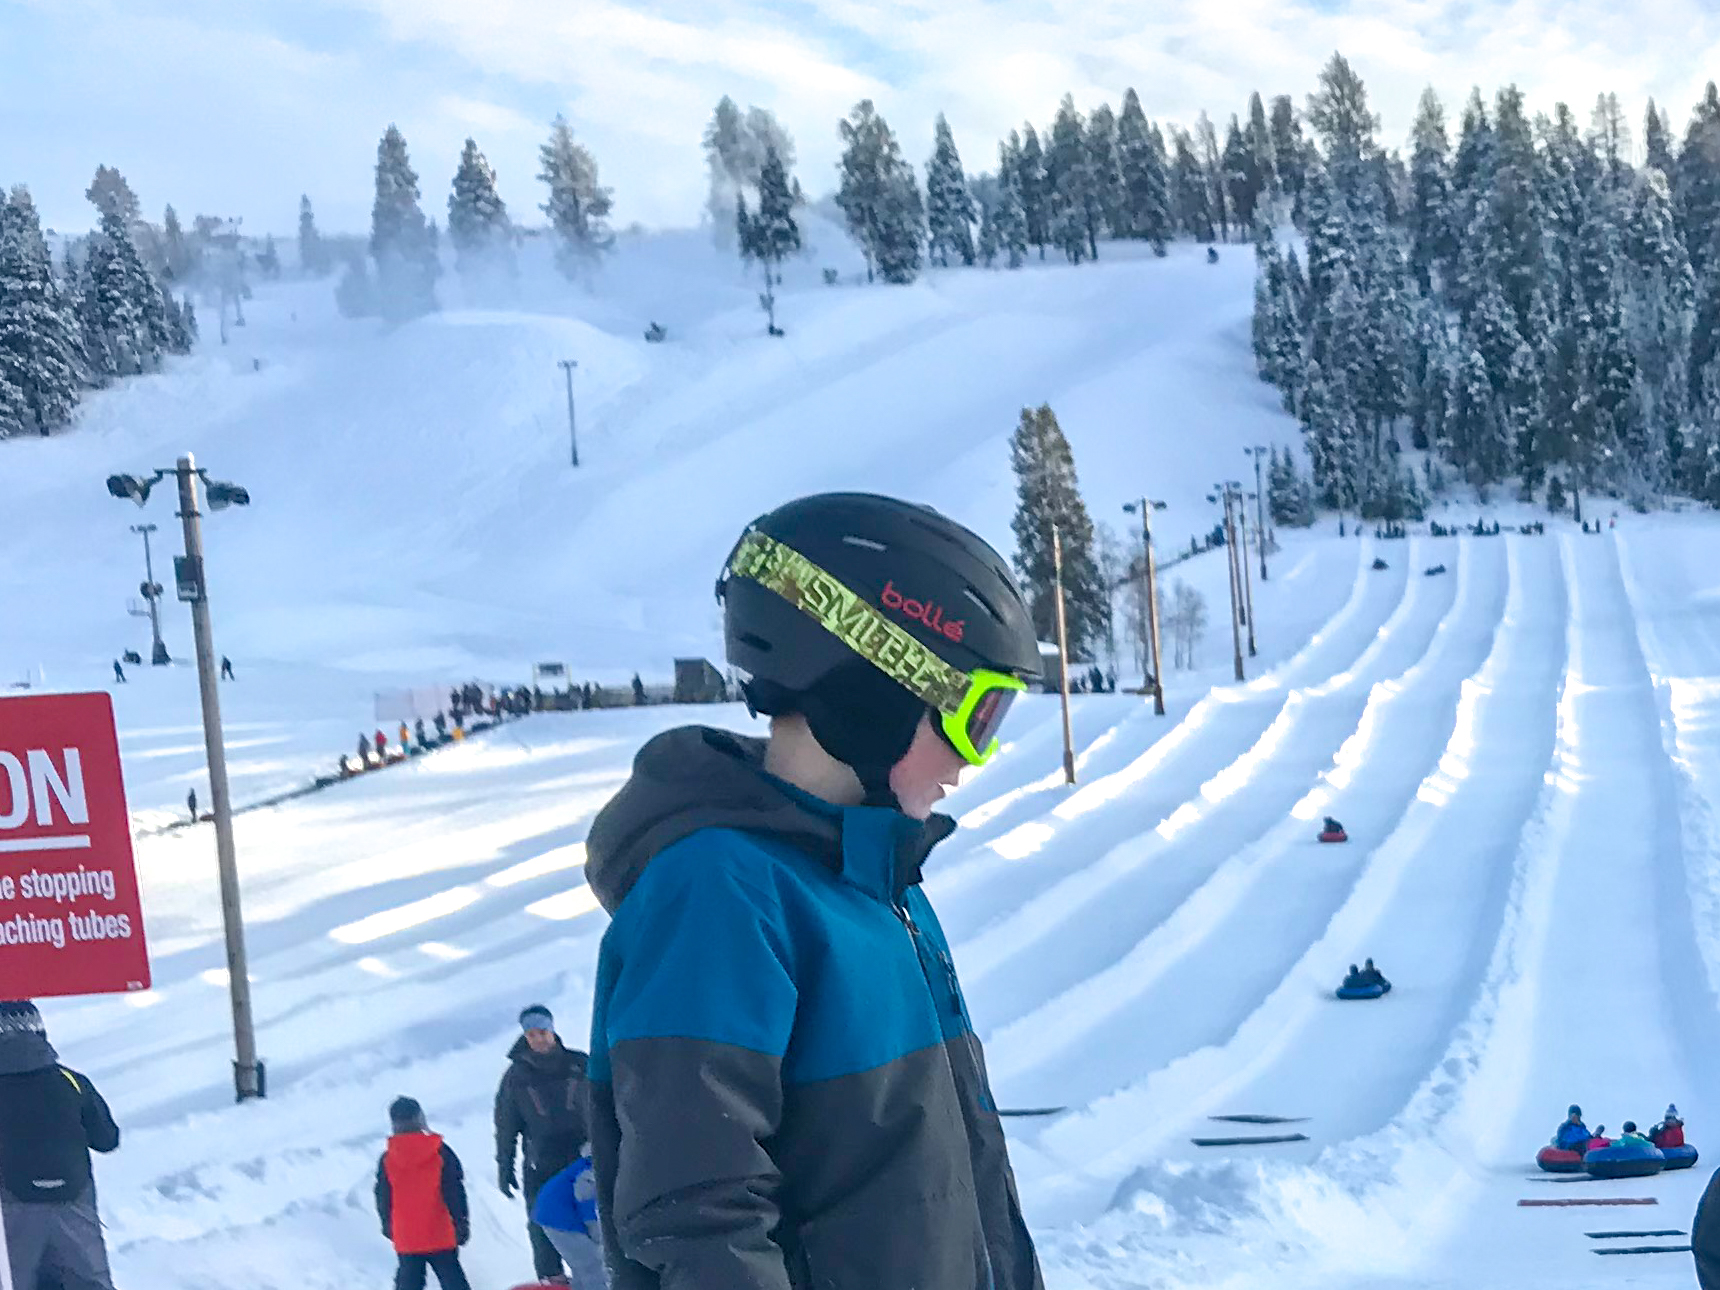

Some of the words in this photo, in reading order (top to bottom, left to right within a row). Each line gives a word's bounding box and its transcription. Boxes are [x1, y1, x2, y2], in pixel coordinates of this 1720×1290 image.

[0, 875, 16, 900] e
[20, 864, 116, 903] stopping
[68, 909, 131, 940] tubes
